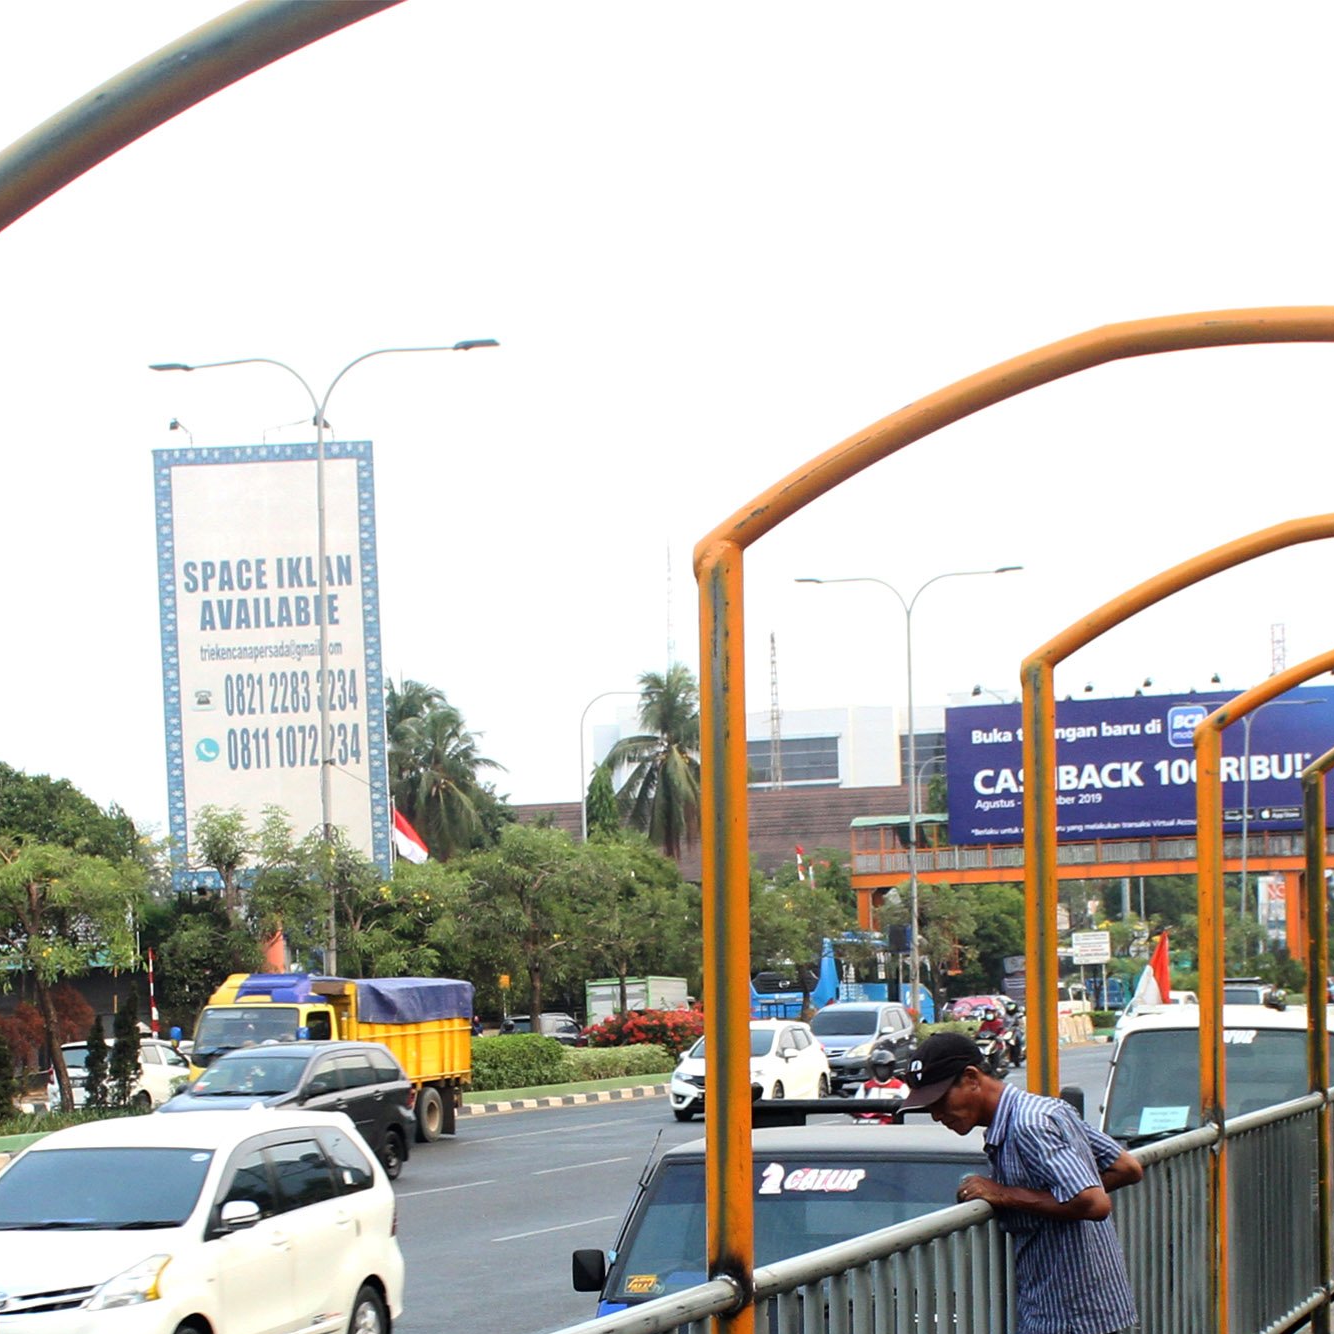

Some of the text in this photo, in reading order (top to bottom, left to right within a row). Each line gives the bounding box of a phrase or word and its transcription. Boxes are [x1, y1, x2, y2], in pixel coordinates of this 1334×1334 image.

[183, 555, 352, 592] SPACE IKLAN
[225, 673, 264, 716] 0821
[269, 670, 310, 714] 2283
[227, 728, 270, 770] 0811
[276, 724, 318, 768] 1072
[971, 719, 1161, 744] Buka tngan baru di
[973, 761, 1144, 795] CABACK
[975, 799, 1015, 811] Agustus
[1078, 793, 1102, 804] 2019
